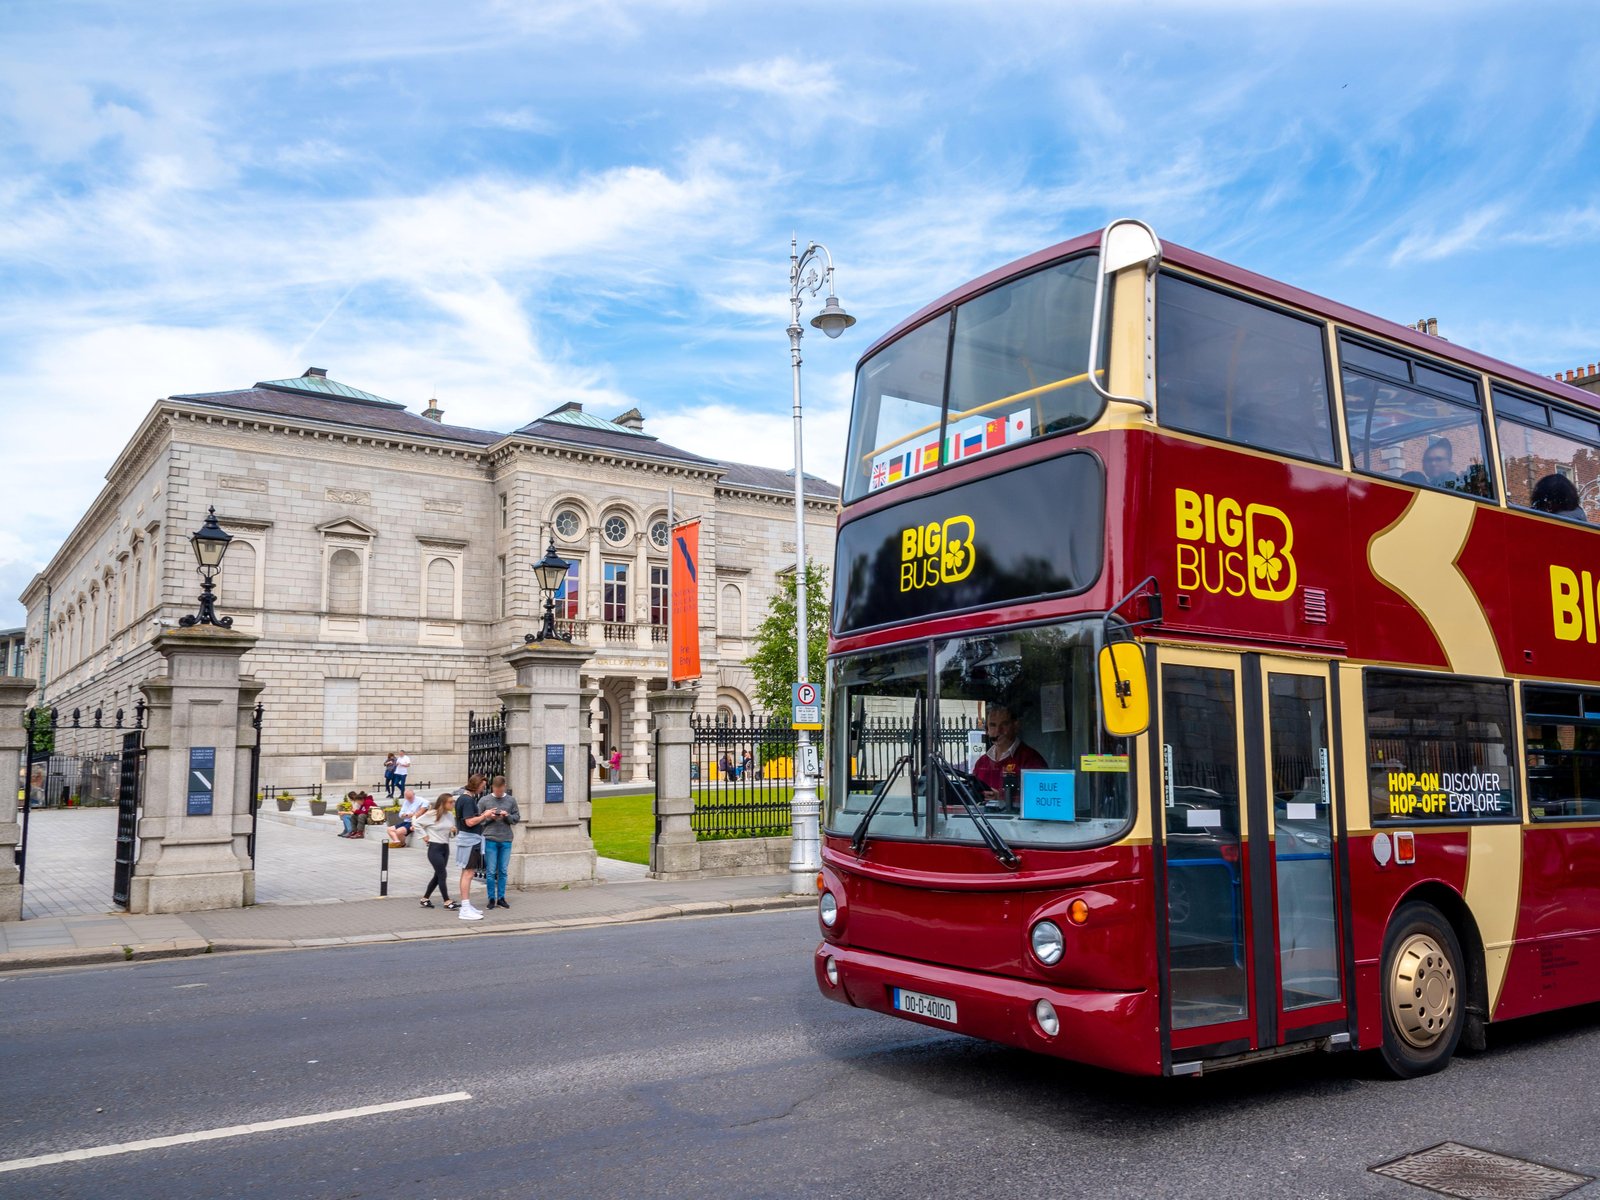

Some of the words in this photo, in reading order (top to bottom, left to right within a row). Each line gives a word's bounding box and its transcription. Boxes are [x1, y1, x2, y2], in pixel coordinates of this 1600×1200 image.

[1175, 487, 1244, 548] BIG
[901, 521, 942, 562] BIG
[900, 556, 940, 593] BUS
[1176, 543, 1247, 597] BUS
[1549, 564, 1600, 644] BI
[807, 748, 813, 757] P
[1039, 782, 1058, 792] BLUE
[1388, 772, 1440, 792] HOP-ON
[1442, 773, 1500, 792] DISCOVER
[1035, 798, 1062, 807] ROUTE
[1389, 793, 1447, 814] HOP-OFF
[1448, 793, 1502, 812] EXPLORE
[905, 995, 951, 1020] 00-D-40100
